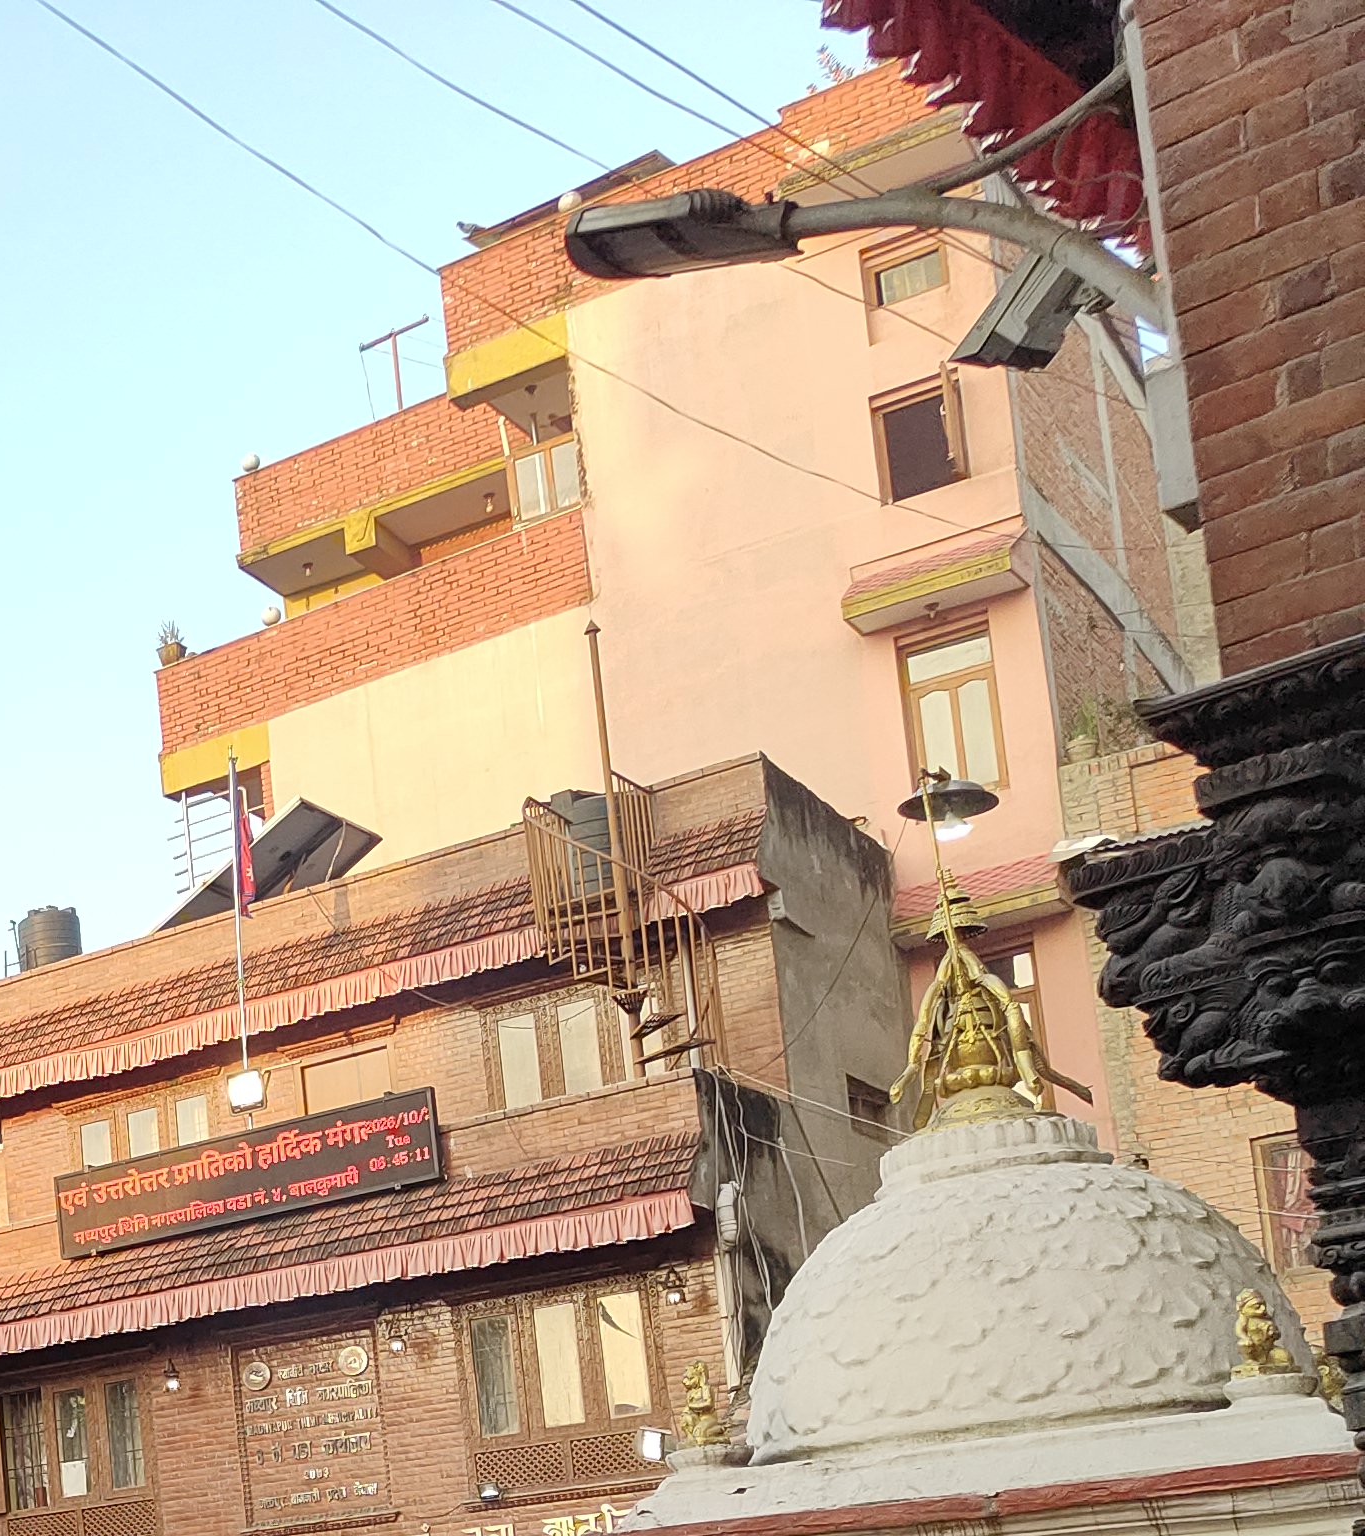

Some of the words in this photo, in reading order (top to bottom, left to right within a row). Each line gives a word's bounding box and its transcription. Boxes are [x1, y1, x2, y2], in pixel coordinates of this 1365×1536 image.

[385, 1134, 411, 1149] Tue
[59, 1182, 89, 1215] एवं
[171, 1142, 253, 1185] प्रगतिको
[256, 1129, 322, 1170] हार्दिक
[288, 1165, 360, 1197] बालकुमारी
